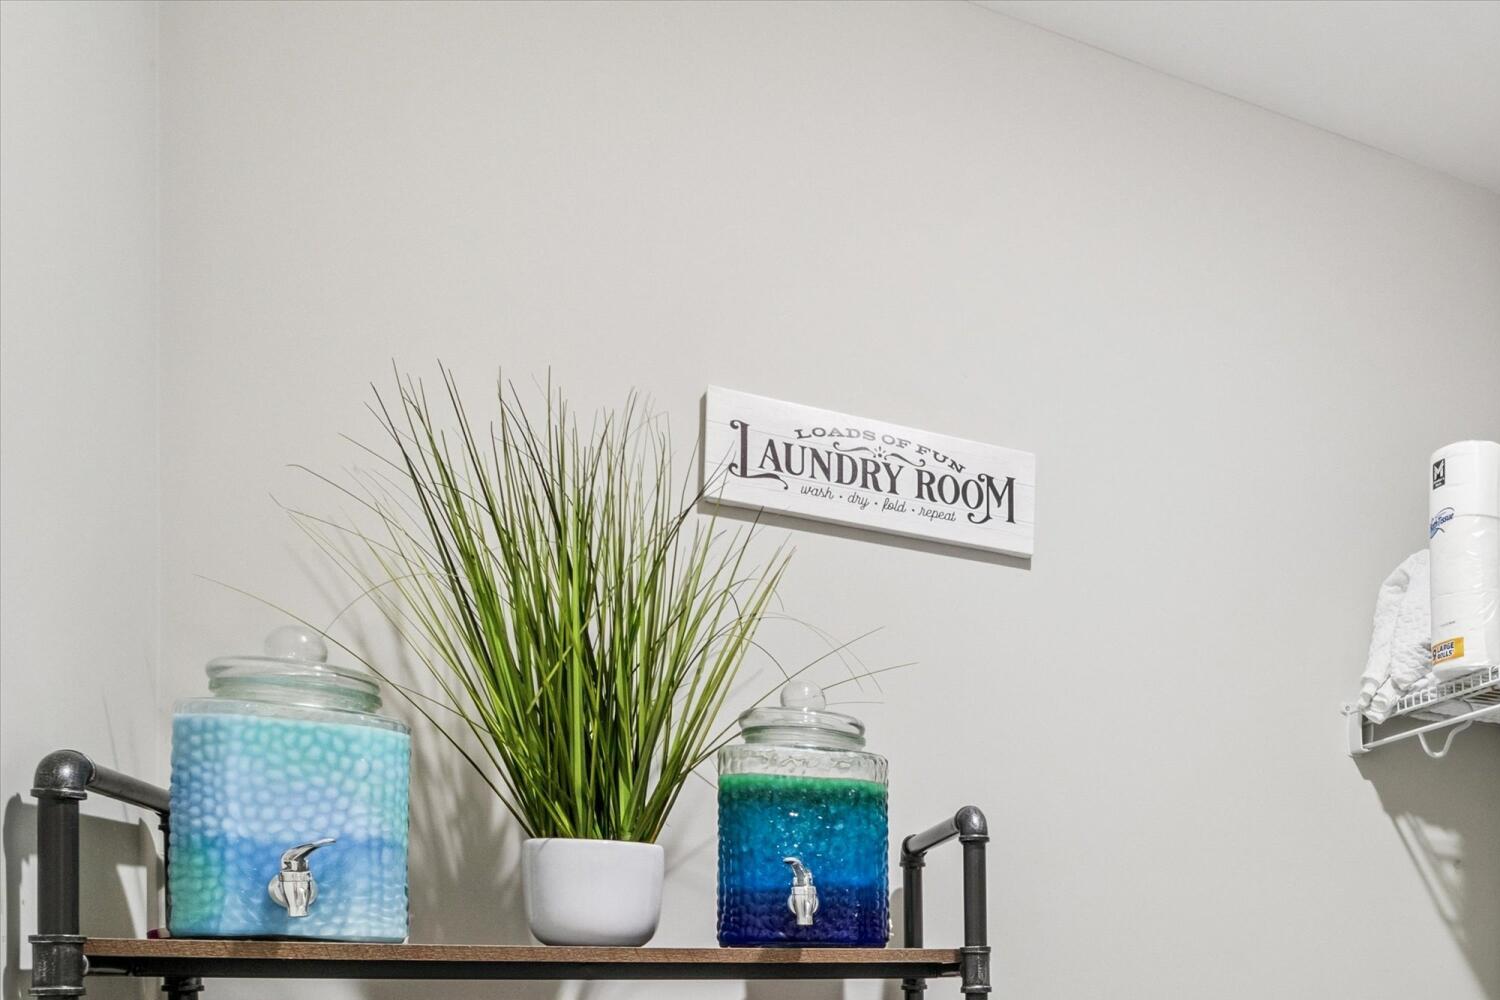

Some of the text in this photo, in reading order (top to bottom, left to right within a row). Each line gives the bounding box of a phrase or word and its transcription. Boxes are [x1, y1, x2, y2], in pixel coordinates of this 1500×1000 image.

[728, 419, 1017, 525] LAUNDRY ROOM
[794, 426, 966, 474] LOADS OF FUN
[800, 484, 957, 523] wash dry fold repeat
